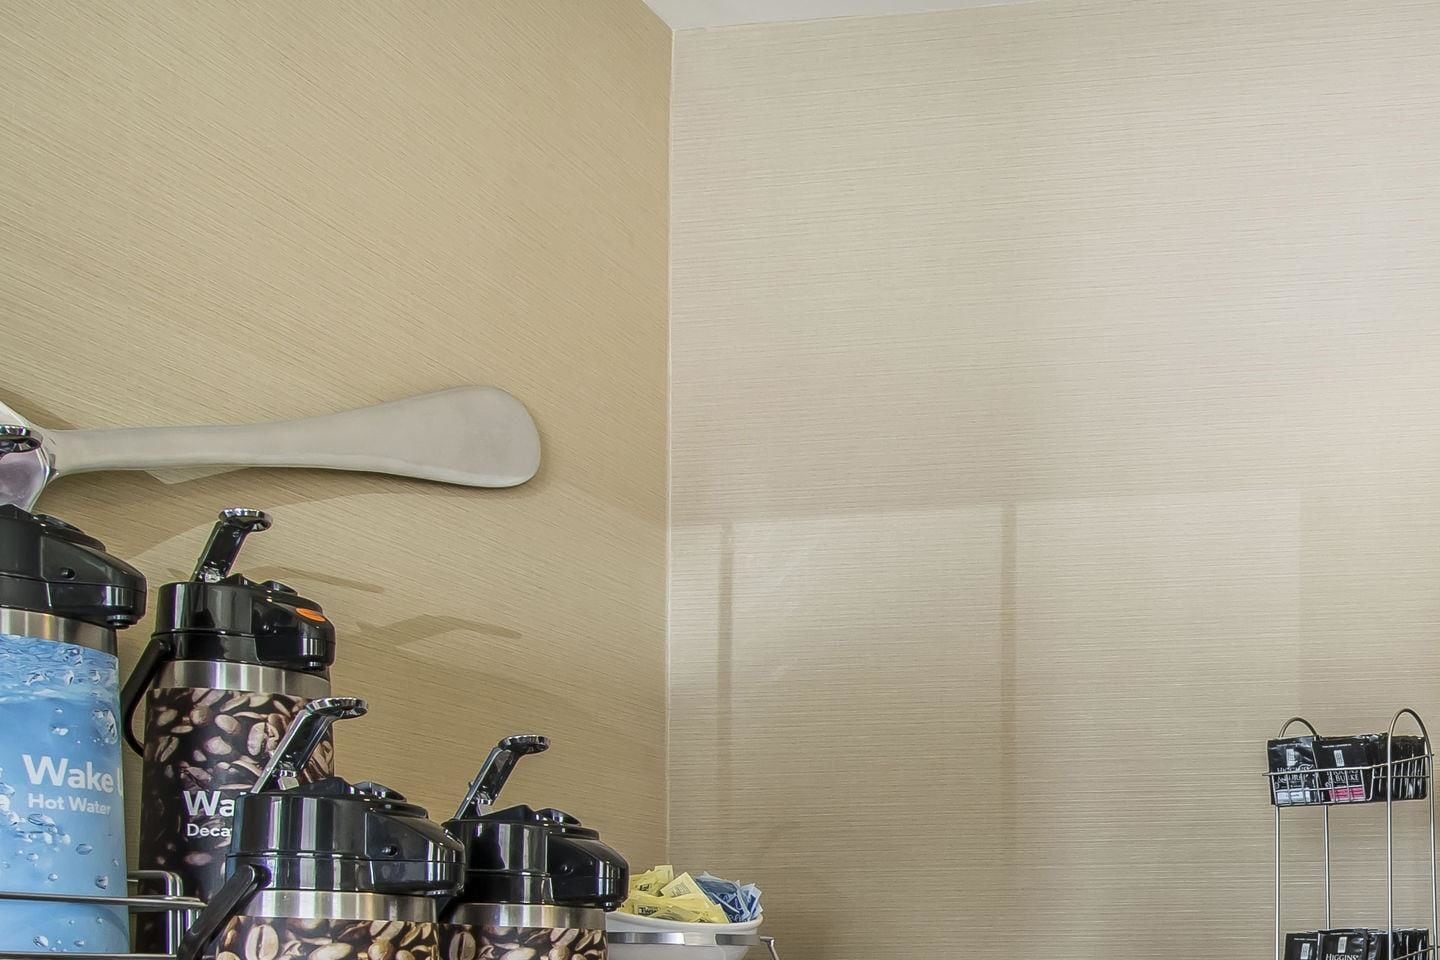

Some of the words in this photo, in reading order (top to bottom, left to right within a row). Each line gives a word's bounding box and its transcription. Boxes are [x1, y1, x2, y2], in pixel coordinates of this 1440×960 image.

[22, 753, 114, 794] Wake
[28, 793, 65, 810] Hot
[67, 796, 112, 816] Water
[183, 790, 236, 817] Wa
[187, 823, 233, 838] Deca
